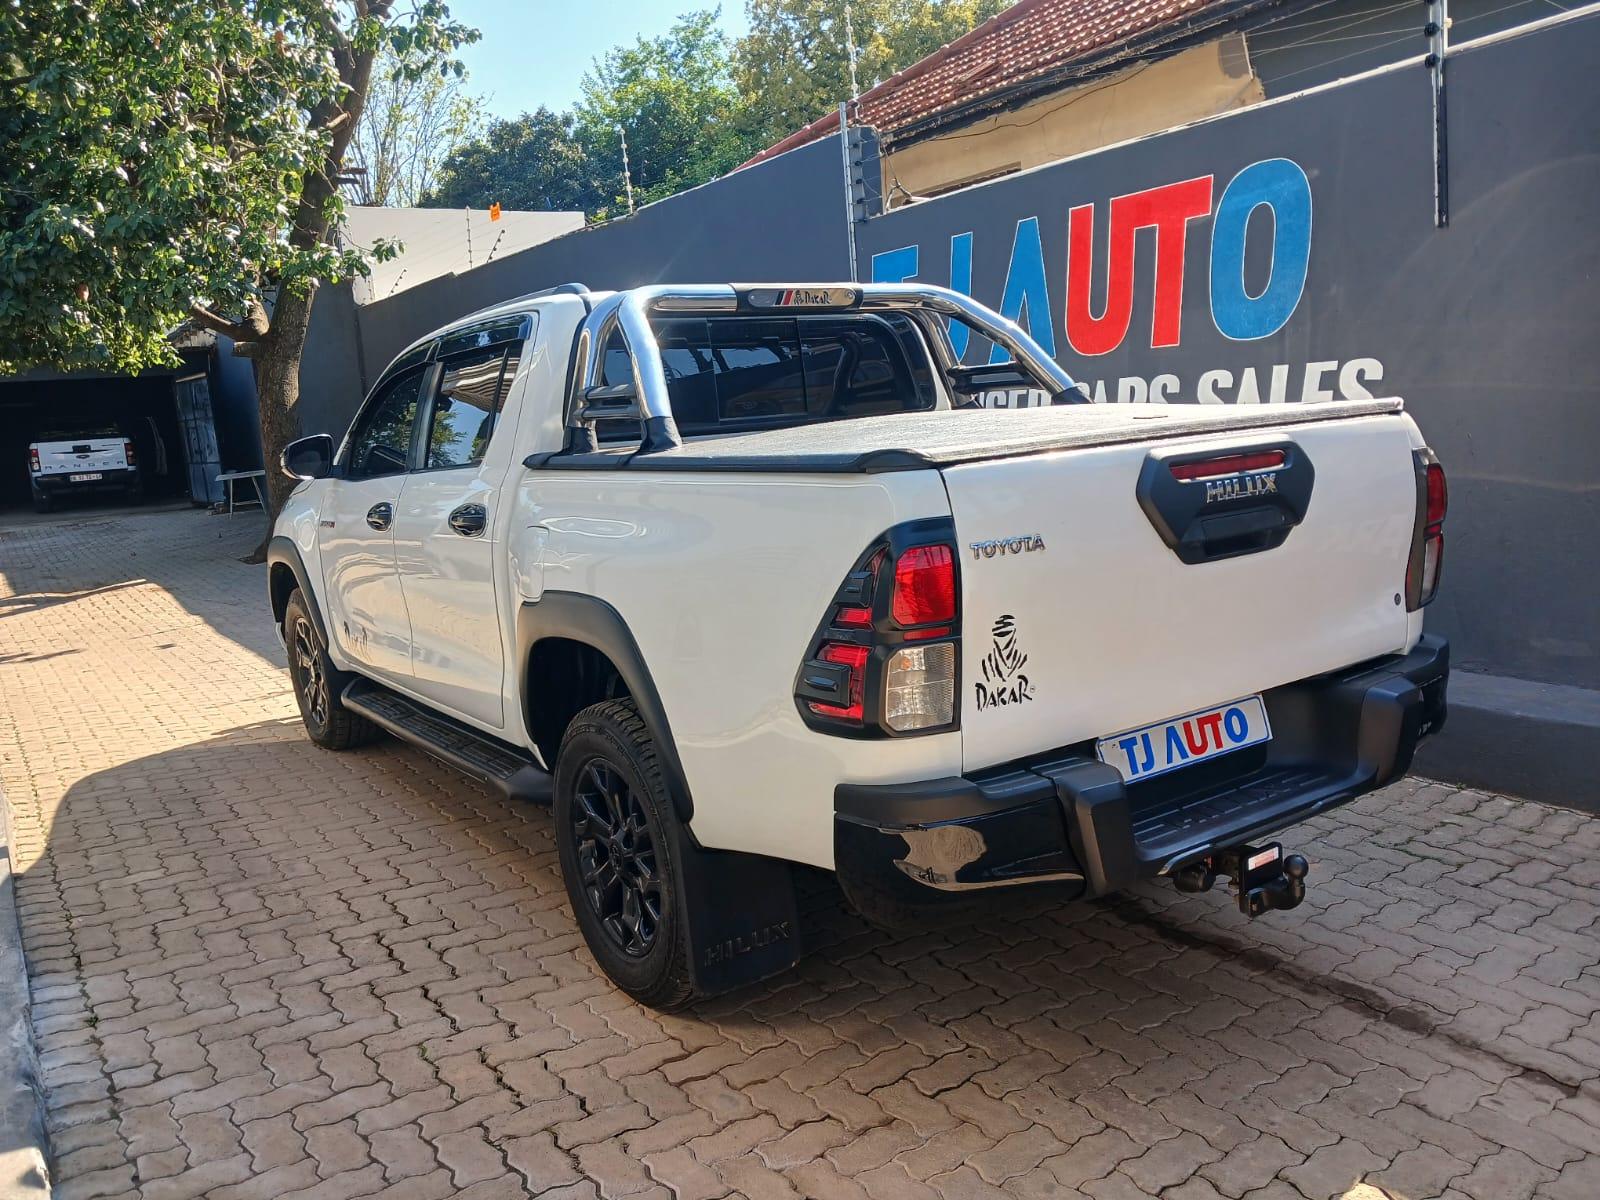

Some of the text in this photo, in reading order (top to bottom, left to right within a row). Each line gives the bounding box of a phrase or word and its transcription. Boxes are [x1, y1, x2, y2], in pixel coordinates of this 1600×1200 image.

[987, 157, 1313, 366] AUTO
[44, 460, 124, 470] RANGER
[1205, 472, 1278, 503] HILUX
[969, 533, 1046, 560] TOYOTA
[974, 674, 1033, 712] DAKAR
[1118, 706, 1249, 776] TJ AUTO
